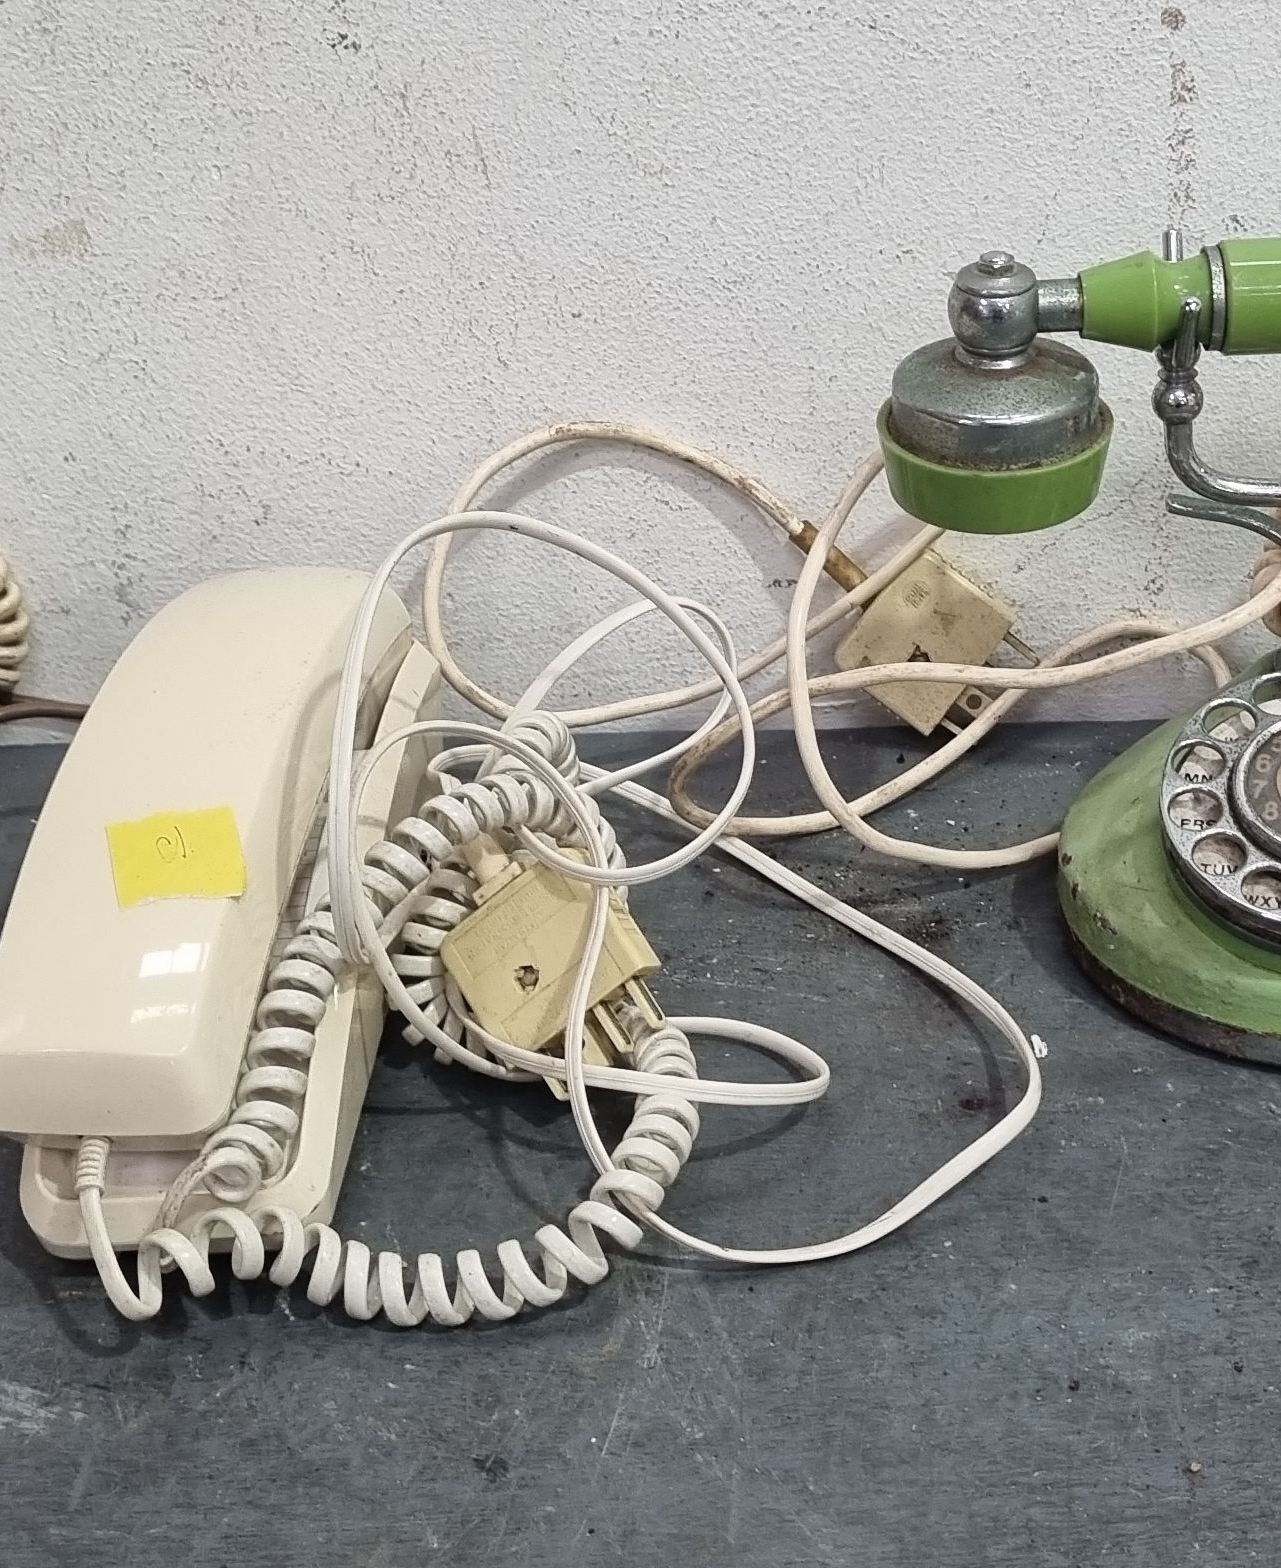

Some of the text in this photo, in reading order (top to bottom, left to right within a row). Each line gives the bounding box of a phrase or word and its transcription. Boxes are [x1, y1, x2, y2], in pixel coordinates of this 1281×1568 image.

[1254, 753, 1272, 773] 6
[1252, 779, 1268, 799] 7
[1263, 801, 1279, 821] 8
